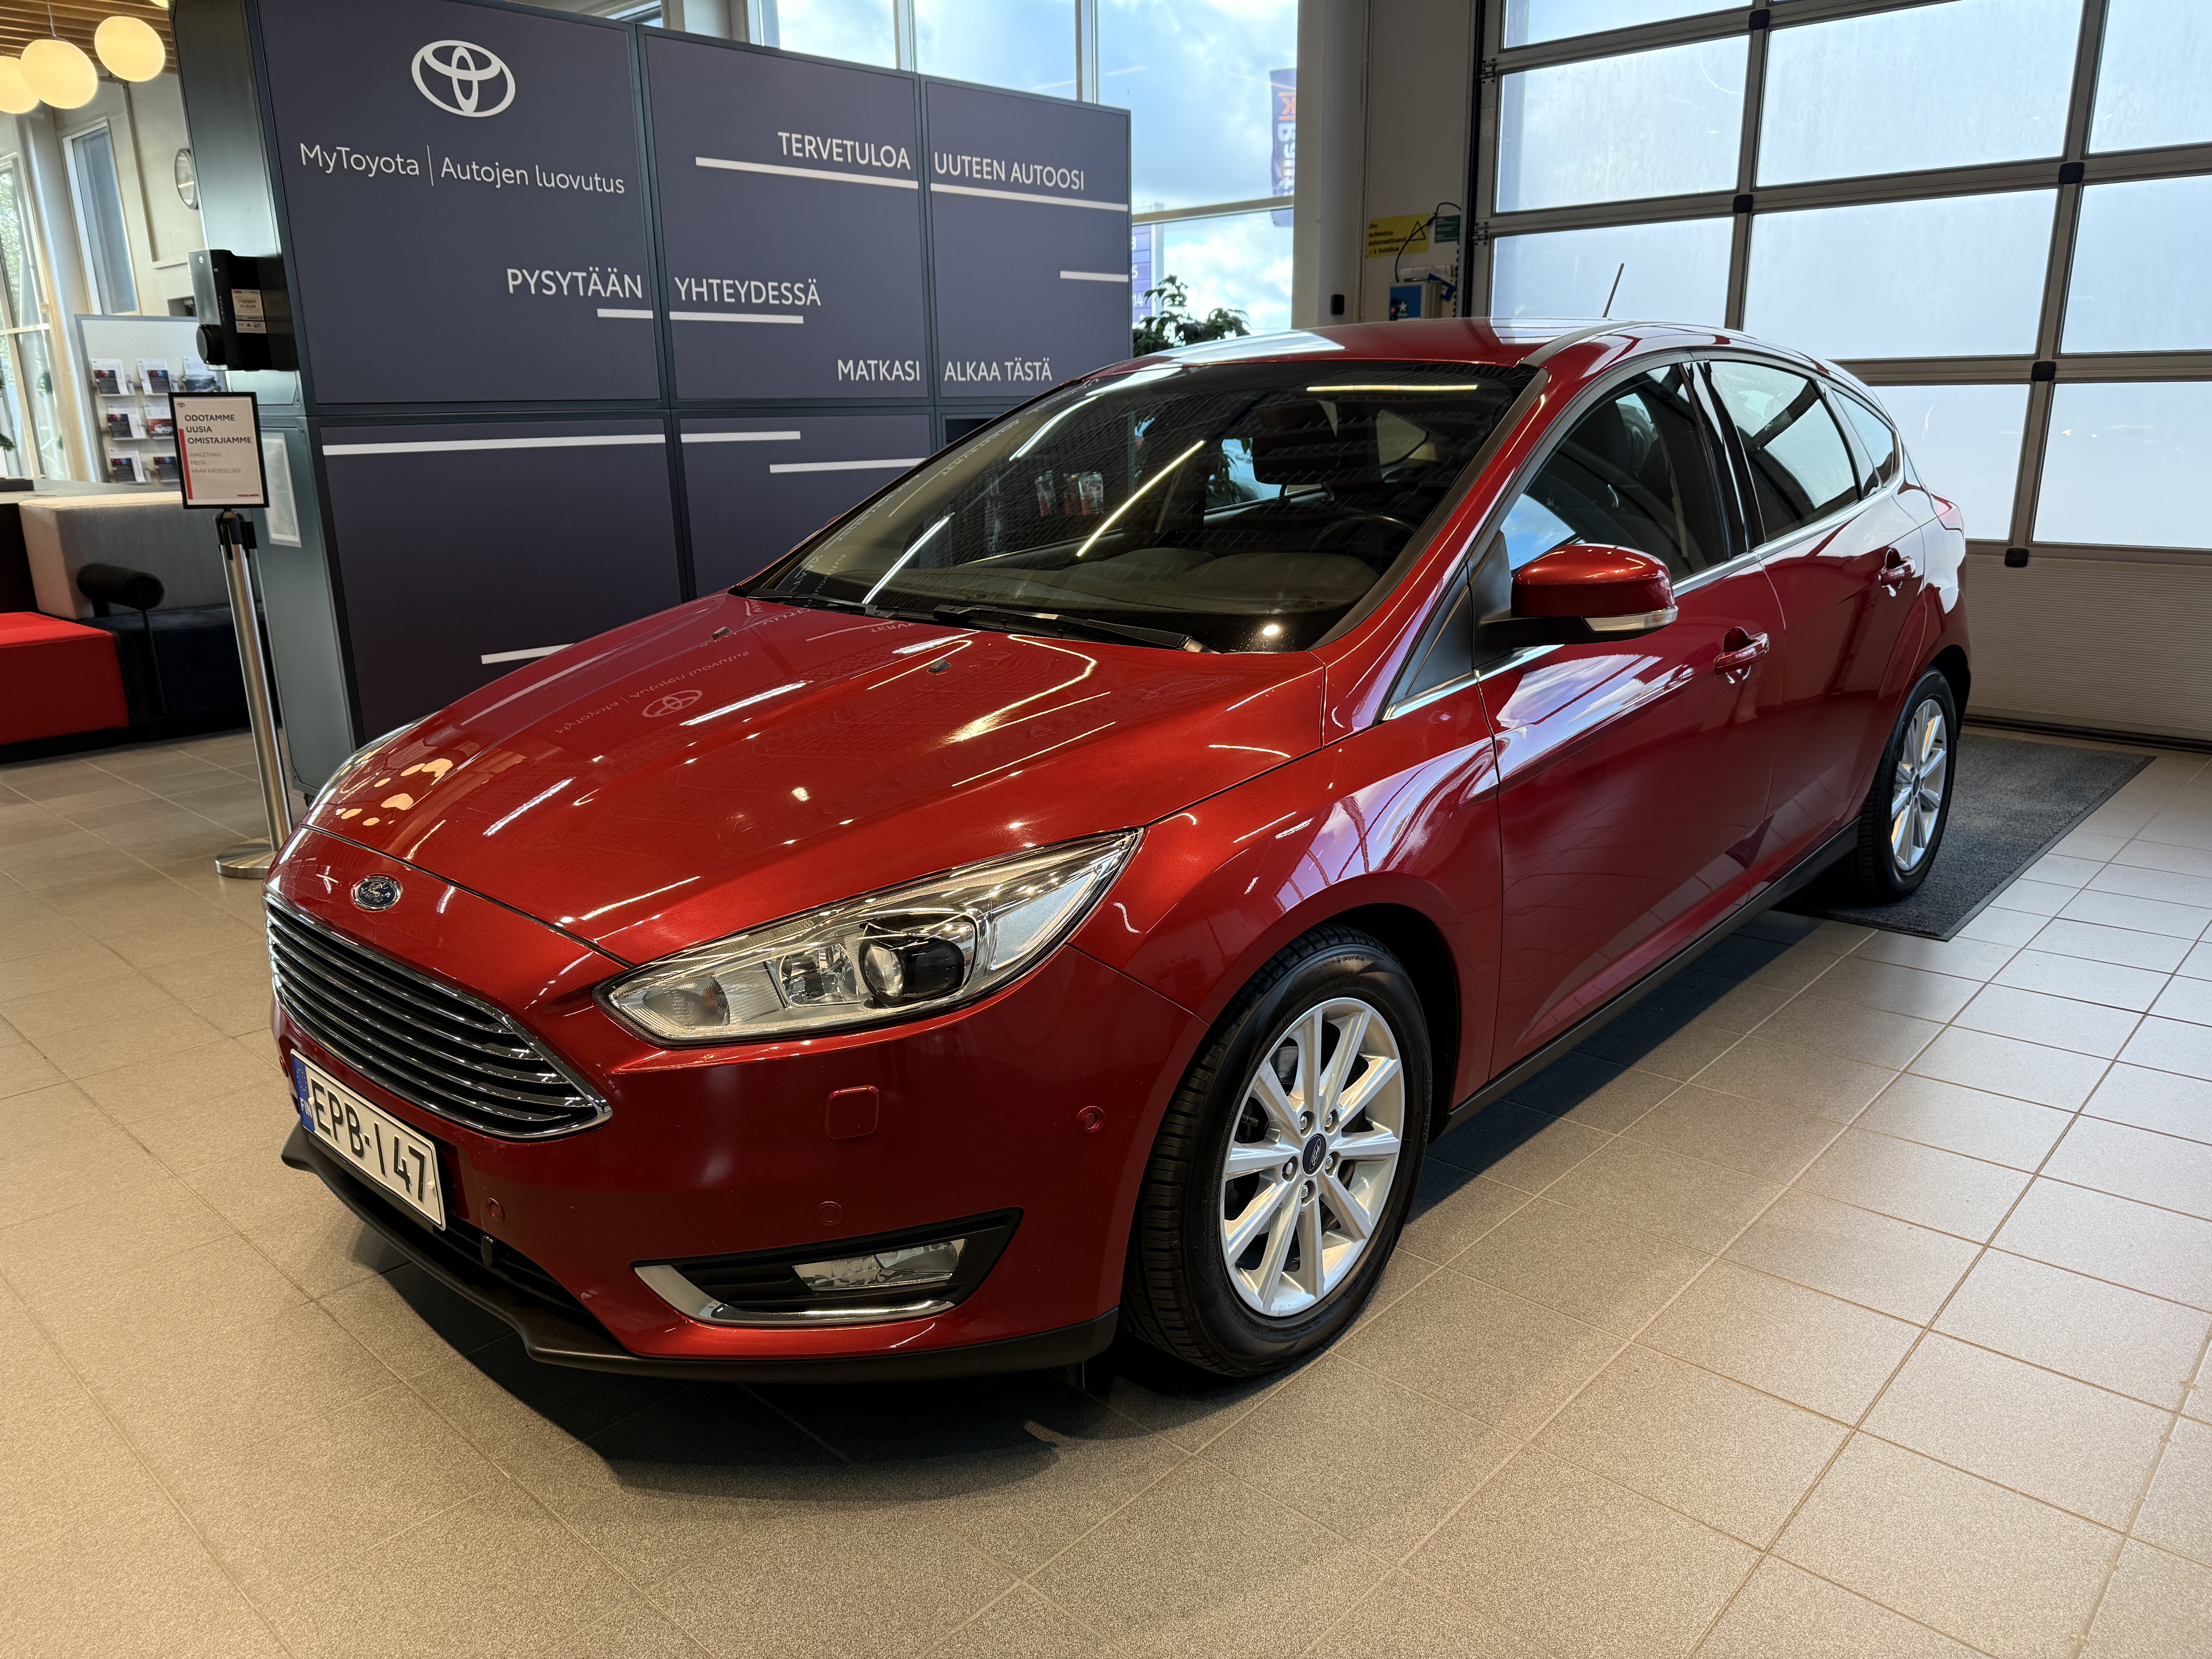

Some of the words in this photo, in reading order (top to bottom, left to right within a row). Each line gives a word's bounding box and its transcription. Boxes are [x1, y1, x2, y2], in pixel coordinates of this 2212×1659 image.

[300, 143, 419, 177] MyToyota
[441, 157, 529, 188] Autojen
[536, 165, 625, 194] luovutus
[777, 132, 911, 170] TERVETULOA
[934, 152, 1006, 182] UUTEEN
[1010, 162, 1085, 190] AUTOOSI
[507, 266, 642, 298] PYSYTÄÄN
[674, 277, 821, 306] YHTEYDESSÄ
[838, 359, 920, 381] MATKASI
[944, 361, 1001, 381] ALKAA
[1004, 357, 1053, 381] TÄSTÄ
[300, 1097, 313, 1119] FIN
[311, 1077, 426, 1203] EPB-147
[1311, 1144, 1320, 1166] Ford
